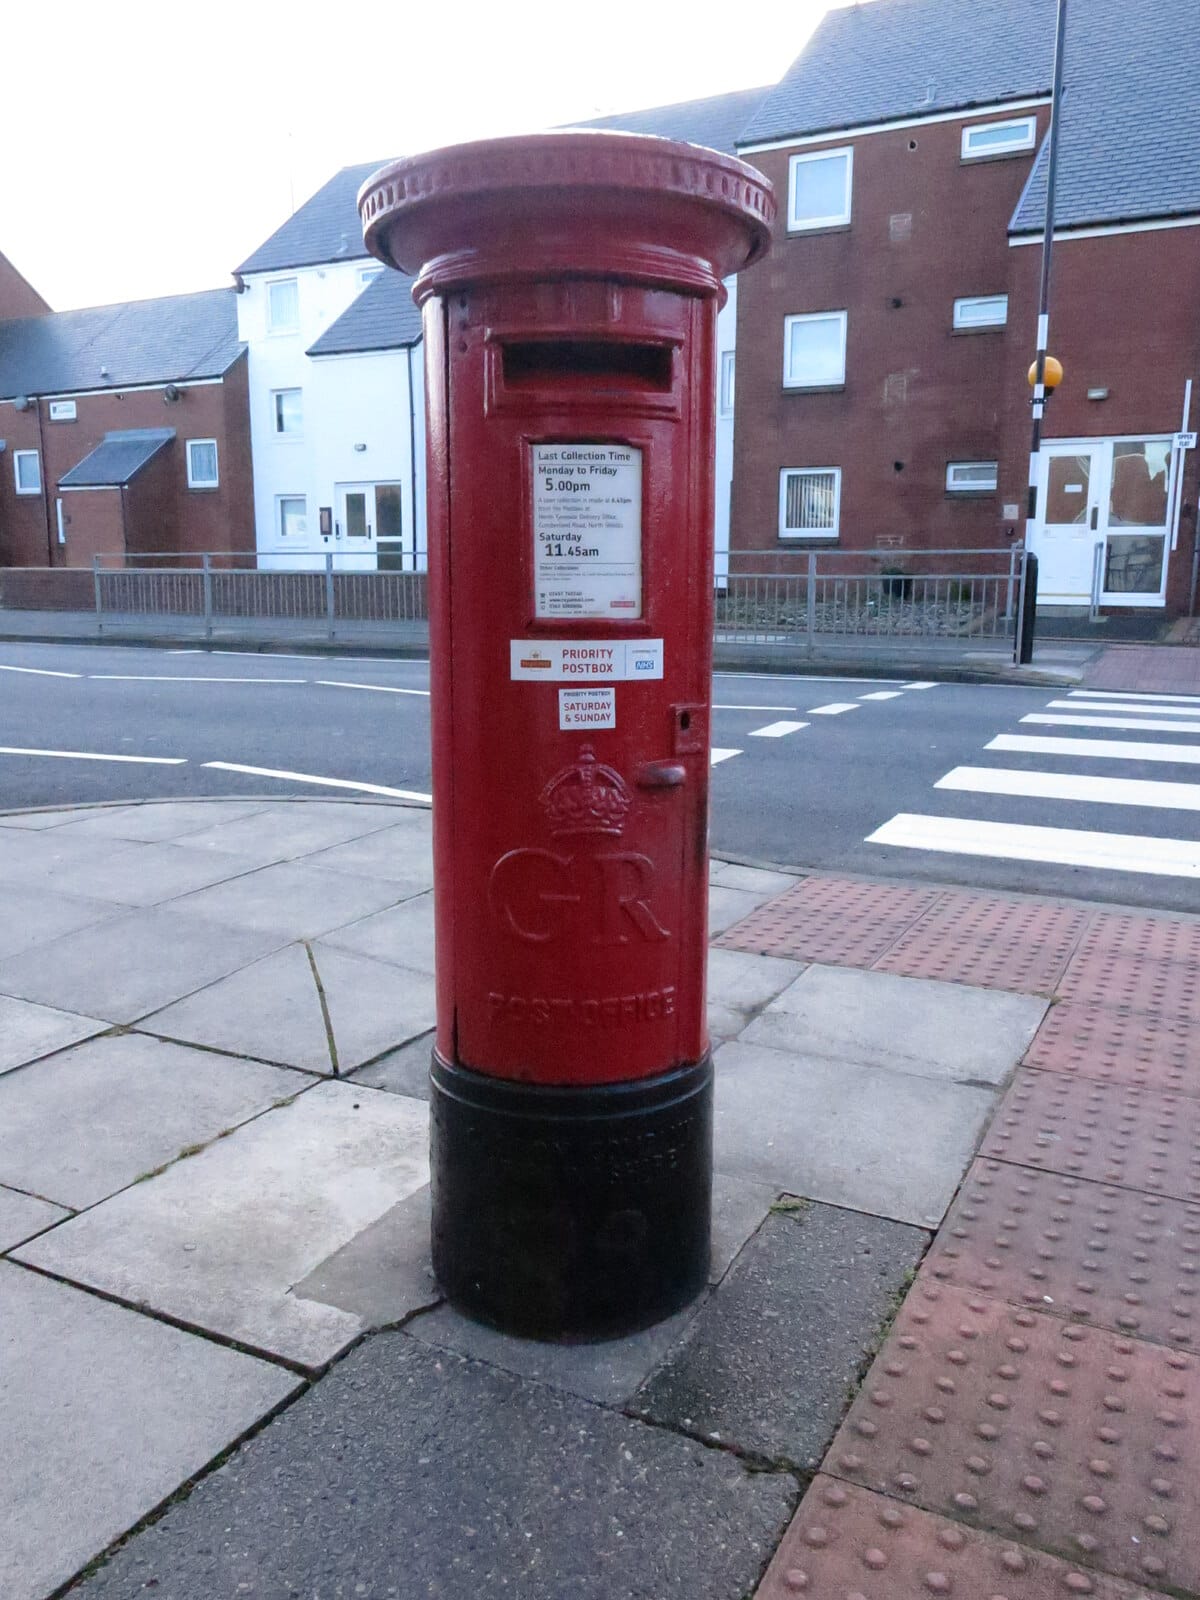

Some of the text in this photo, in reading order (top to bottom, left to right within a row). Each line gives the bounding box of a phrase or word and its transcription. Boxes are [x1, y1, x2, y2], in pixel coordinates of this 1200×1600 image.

[538, 451, 631, 461] Last Collection Time
[538, 466, 618, 476] Monday to Friday
[546, 478, 590, 492] 5.00pm
[540, 532, 582, 542] Saturday
[545, 544, 599, 556] 11.45am
[562, 649, 614, 659] PRIORITY
[562, 664, 613, 673] POSTBOX
[636, 661, 654, 669] NHS
[564, 702, 611, 712] SATURDAY
[565, 712, 611, 722] & SUNDAY
